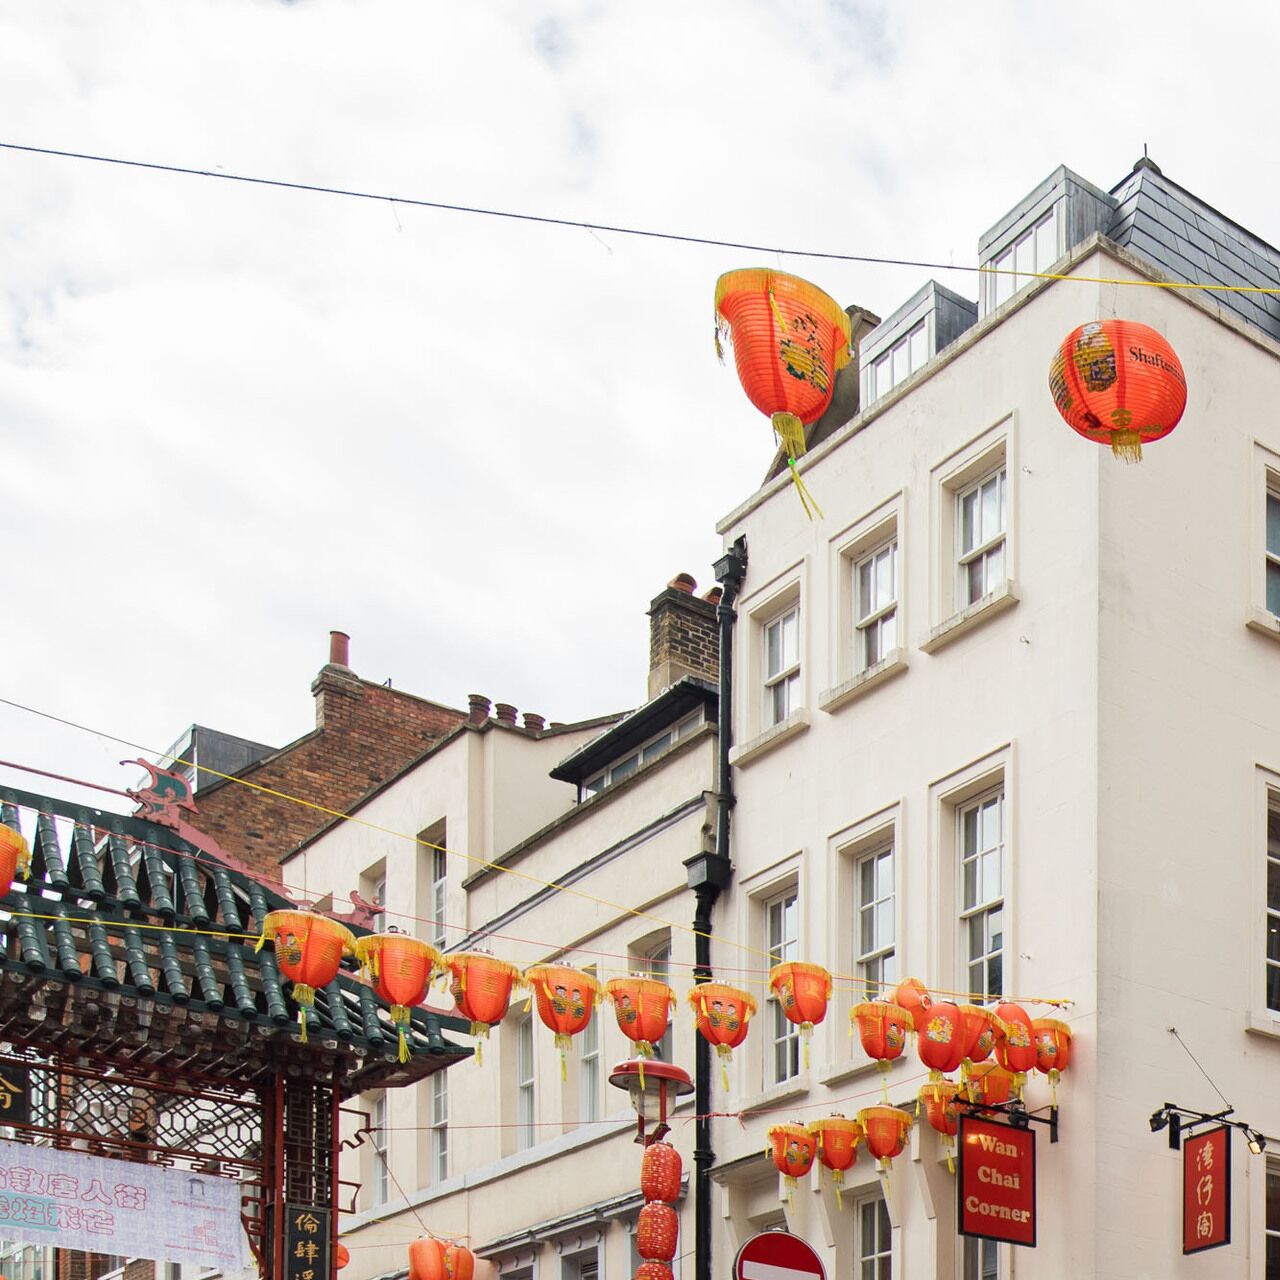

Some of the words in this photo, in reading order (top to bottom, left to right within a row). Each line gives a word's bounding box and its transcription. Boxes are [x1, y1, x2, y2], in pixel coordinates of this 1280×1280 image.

[978, 1134, 1018, 1158] Wan
[0, 1166, 147, 1211] 敦唐人街
[977, 1166, 1020, 1190] Chai
[966, 1196, 1031, 1223] Corner
